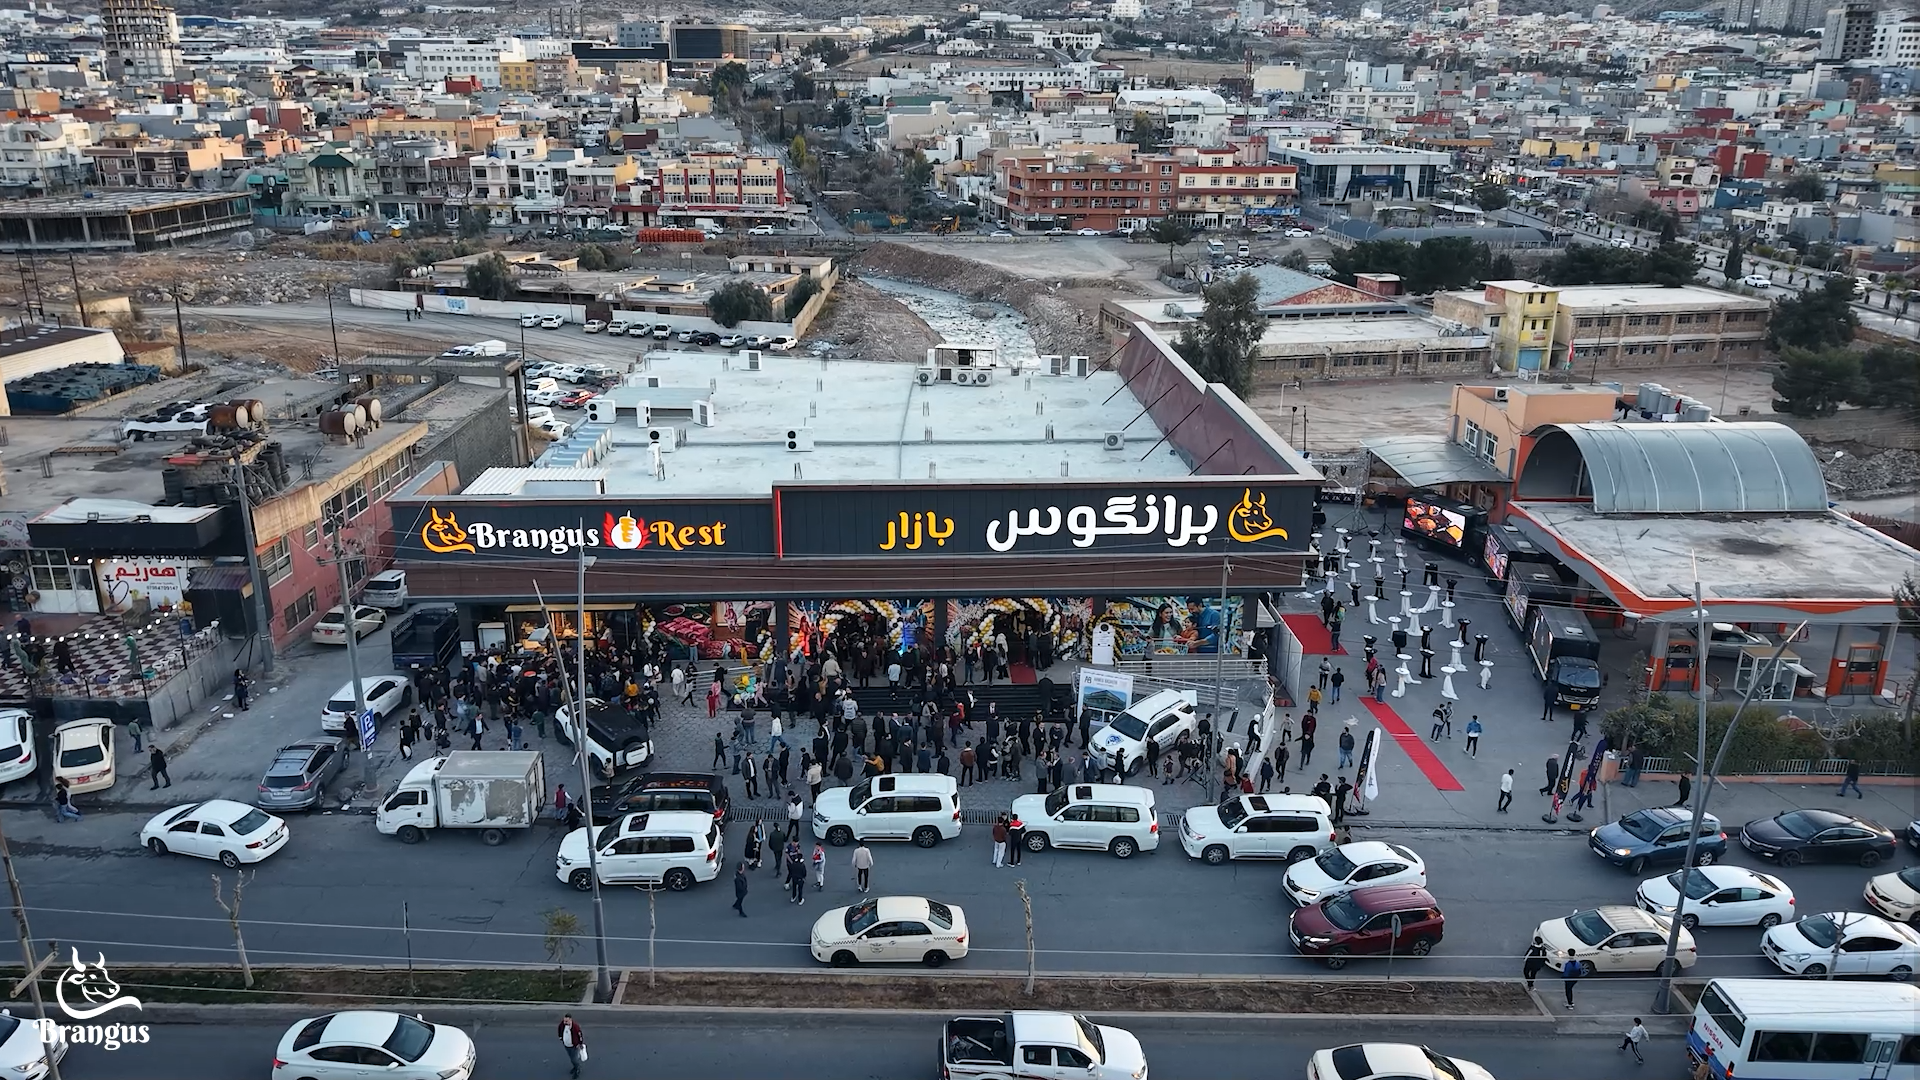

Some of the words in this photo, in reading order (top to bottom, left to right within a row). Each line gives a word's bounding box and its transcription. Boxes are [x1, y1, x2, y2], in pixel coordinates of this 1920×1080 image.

[468, 522, 599, 554] Brangus
[650, 521, 726, 550] Rest
[879, 511, 955, 550] بازار
[986, 494, 1218, 551] برانگوس
[1703, 1022, 1724, 1049] NISSAN
